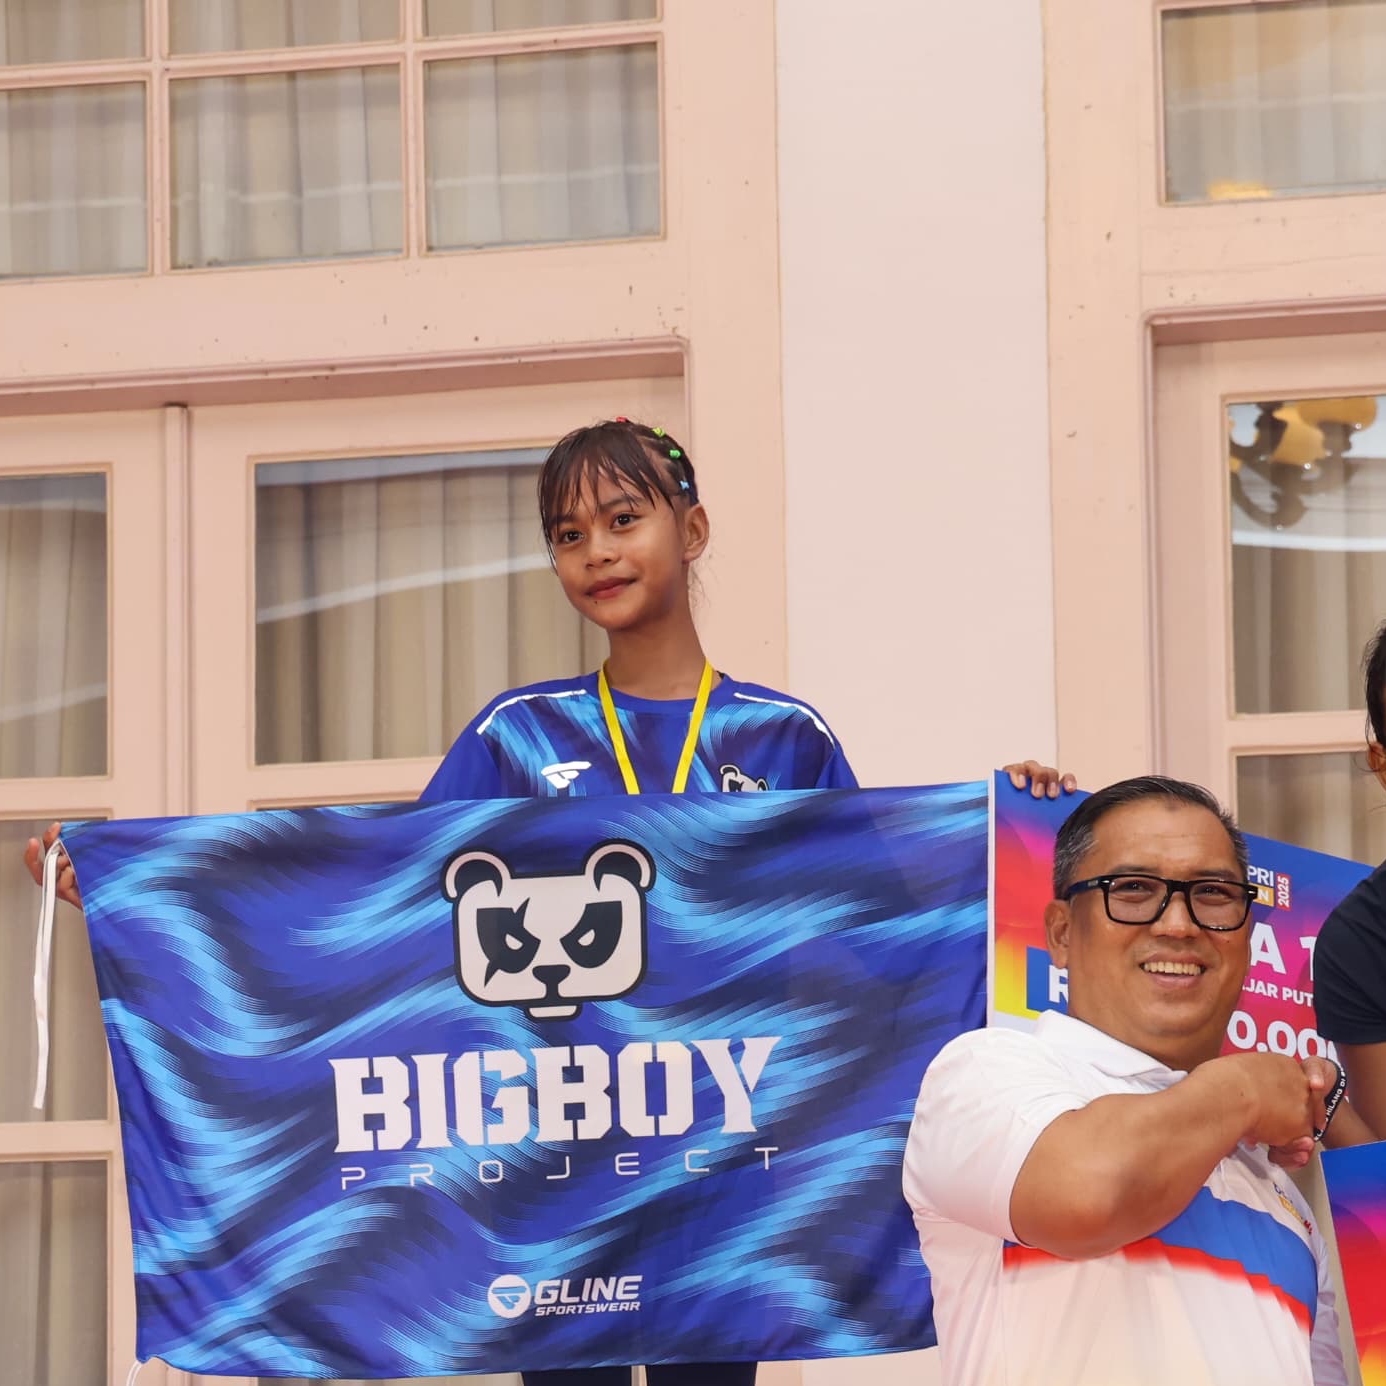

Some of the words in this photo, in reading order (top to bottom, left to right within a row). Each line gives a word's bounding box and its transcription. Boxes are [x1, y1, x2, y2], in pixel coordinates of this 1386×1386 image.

[1278, 876, 1291, 908] 2025
[330, 1036, 781, 1153] BIGBOY
[341, 1146, 780, 1191] PROJECT
[533, 1275, 643, 1305] GLINE
[534, 1301, 641, 1316] SPORTSWEAR
